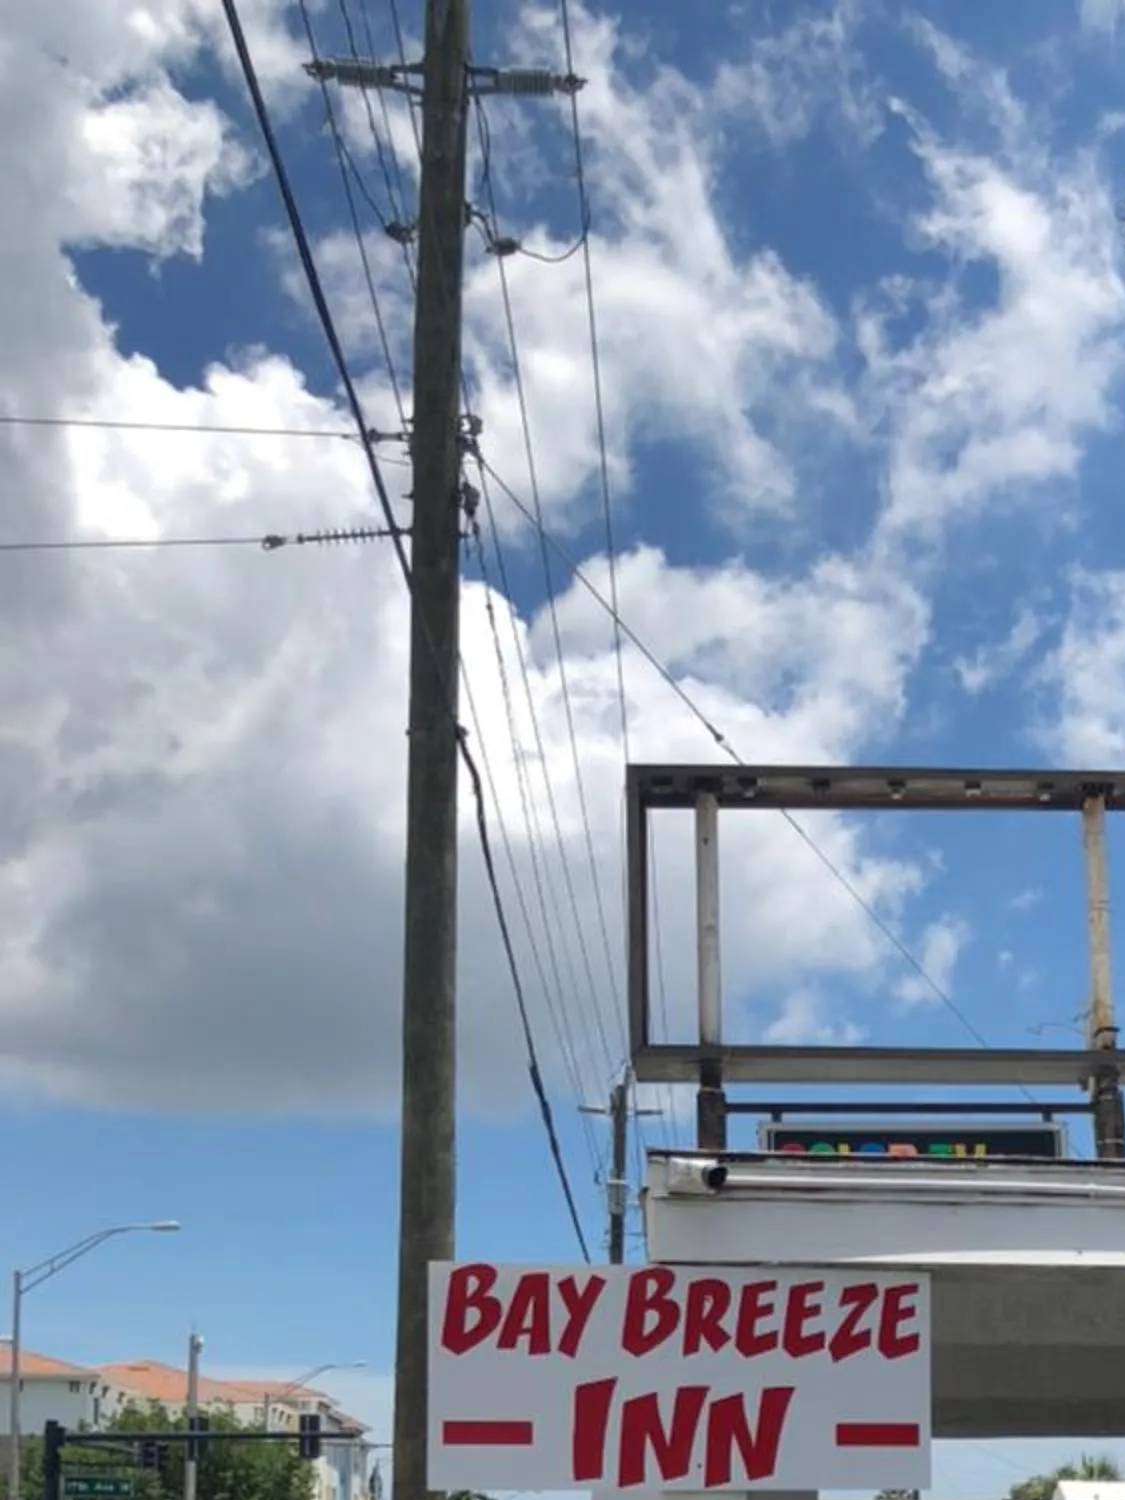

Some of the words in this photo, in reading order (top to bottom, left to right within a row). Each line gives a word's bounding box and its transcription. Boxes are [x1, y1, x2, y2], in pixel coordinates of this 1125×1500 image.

[441, 1264, 606, 1358] BAY
[621, 1265, 920, 1362] BREEZE
[572, 1377, 796, 1488] INN
